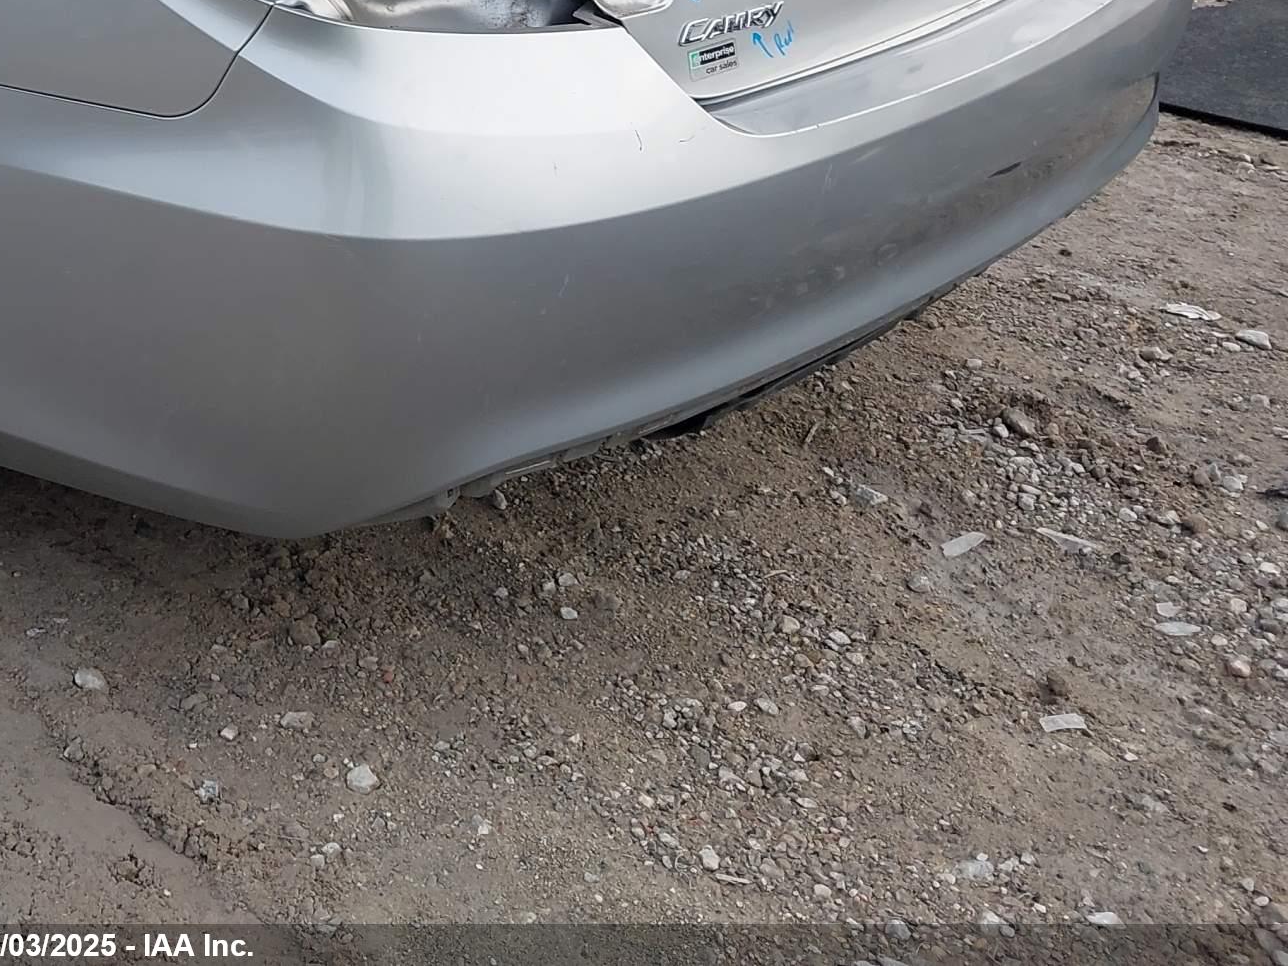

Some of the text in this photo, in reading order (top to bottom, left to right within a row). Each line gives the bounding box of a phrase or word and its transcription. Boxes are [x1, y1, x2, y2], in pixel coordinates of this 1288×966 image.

[679, 1, 784, 46] CAMRY
[691, 45, 735, 68] enterprise
[705, 59, 738, 75] car sales
